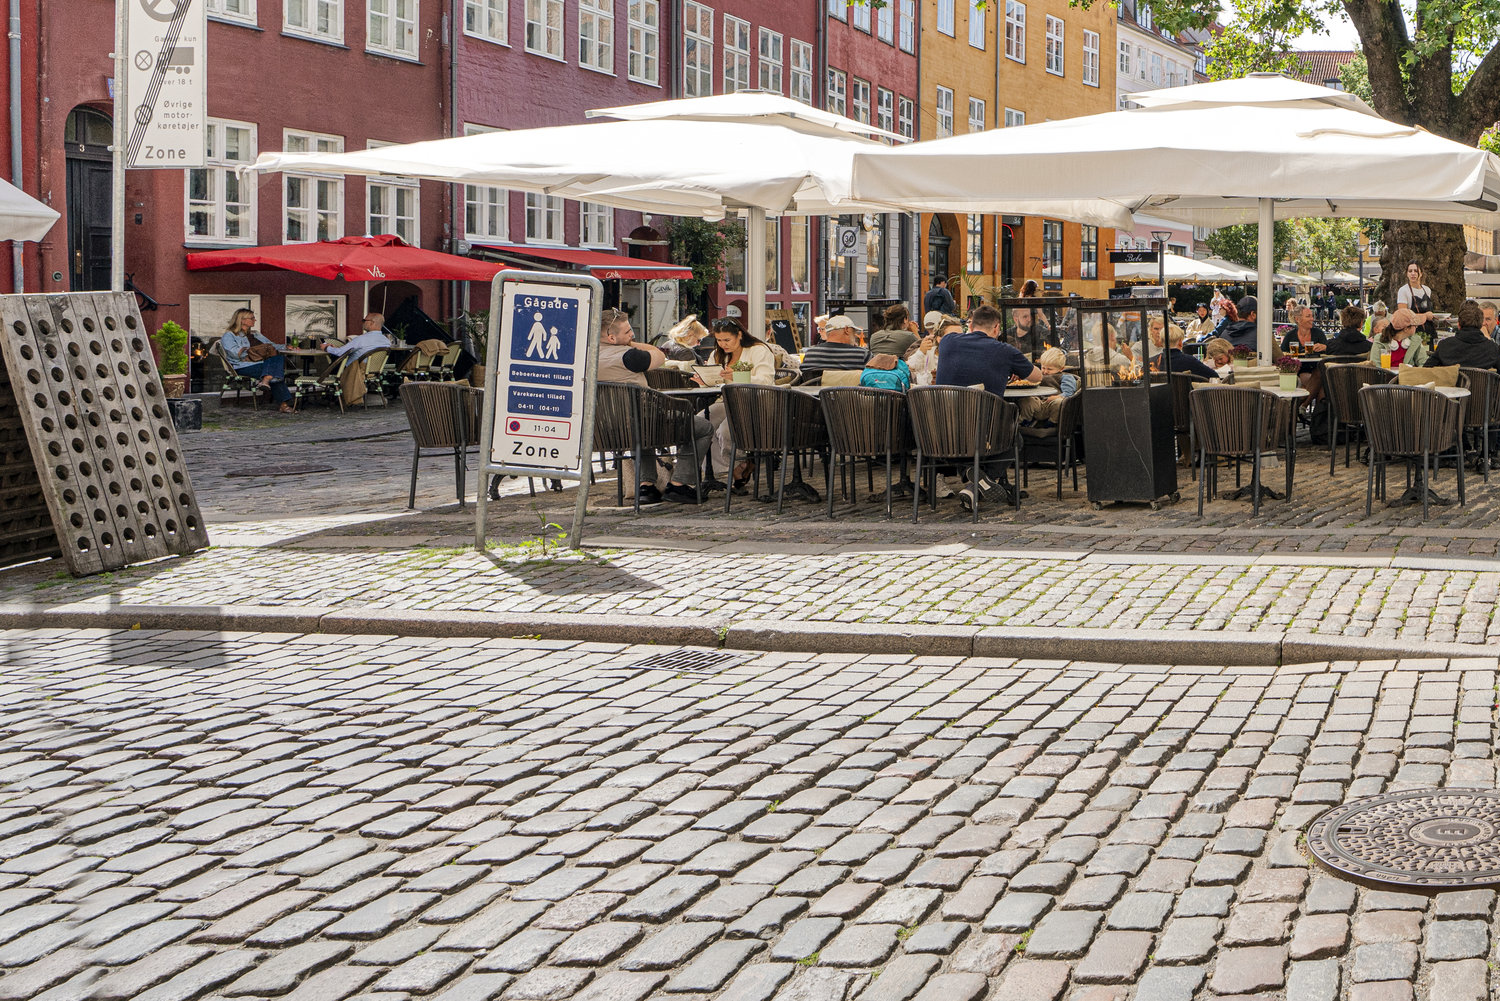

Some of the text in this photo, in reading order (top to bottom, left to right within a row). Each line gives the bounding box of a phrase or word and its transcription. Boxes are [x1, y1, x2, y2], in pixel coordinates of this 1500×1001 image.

[163, 100, 193, 109] Øvrige
[157, 122, 199, 131] køretøjer
[79, 144, 85, 152] 3
[145, 145, 186, 159] Zone
[524, 297, 569, 310] Gågade
[511, 370, 551, 379] Beboerkørsel
[512, 390, 545, 399] Varekørsel
[534, 424, 556, 433] 11-04
[512, 441, 560, 459] Zone
